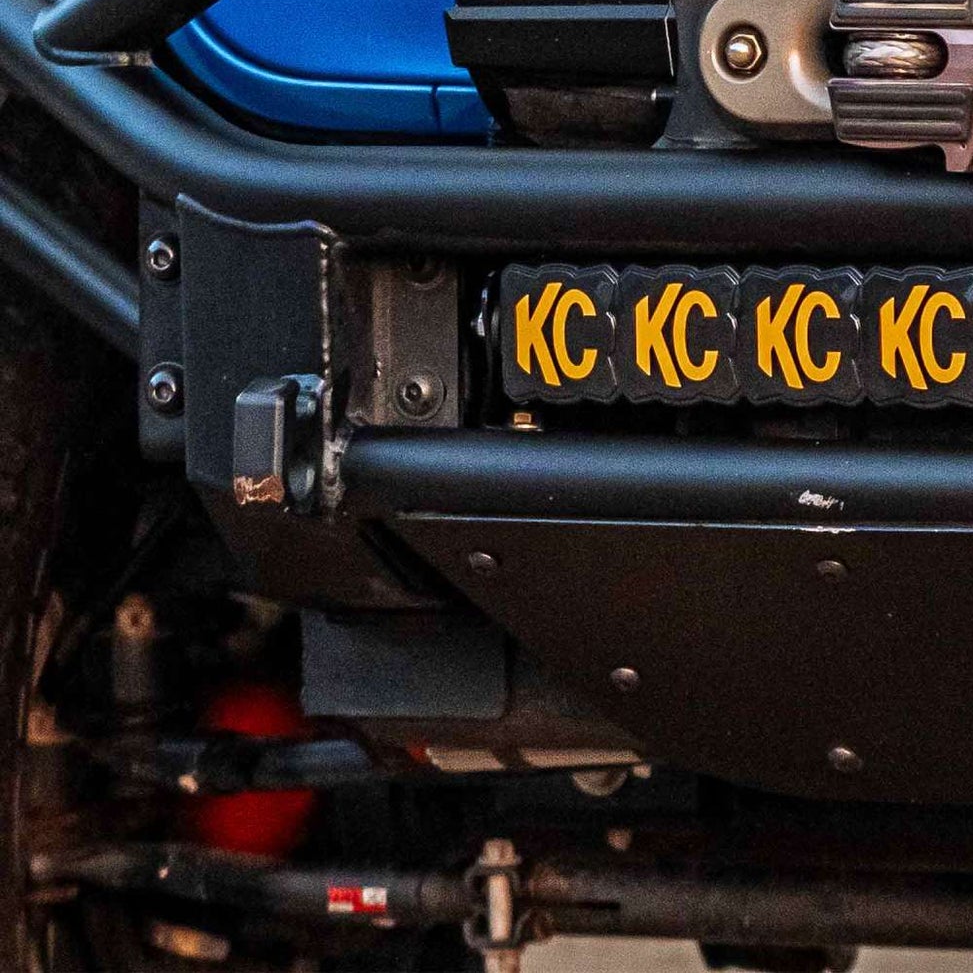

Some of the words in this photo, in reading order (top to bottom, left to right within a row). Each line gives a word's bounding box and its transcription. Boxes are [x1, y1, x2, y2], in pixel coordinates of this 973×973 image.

[516, 283, 597, 386] KC
[635, 283, 718, 387] KC
[757, 284, 841, 389] KC
[880, 285, 965, 389] KC
